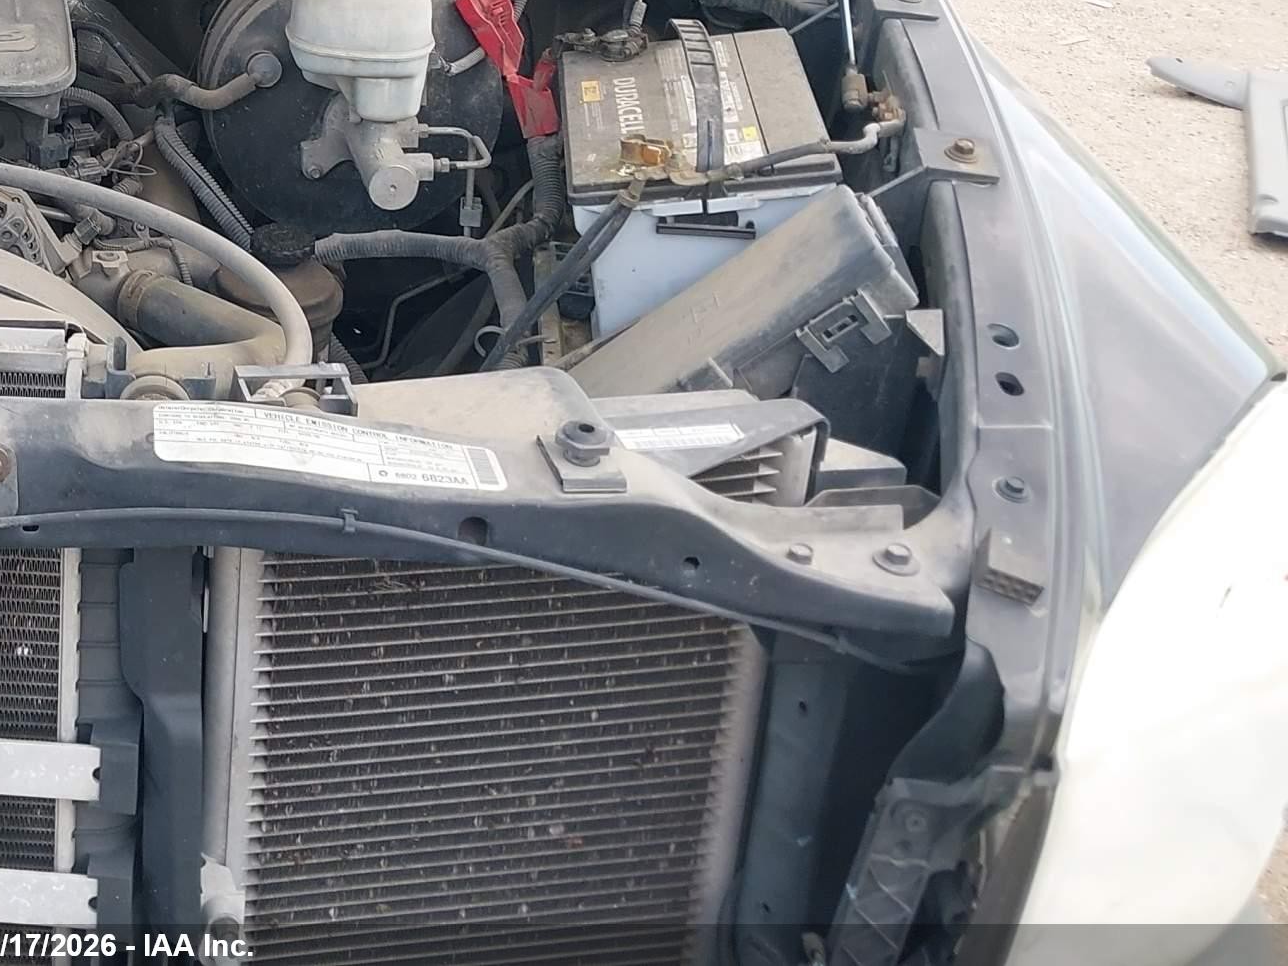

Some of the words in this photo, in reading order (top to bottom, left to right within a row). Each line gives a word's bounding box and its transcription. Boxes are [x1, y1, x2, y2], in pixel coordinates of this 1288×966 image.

[612, 76, 645, 135] DURACELL
[264, 411, 302, 423] VEHICLE
[306, 418, 348, 433] EMISSION
[352, 427, 389, 440] CONTROL
[396, 435, 454, 450] INFORMATION
